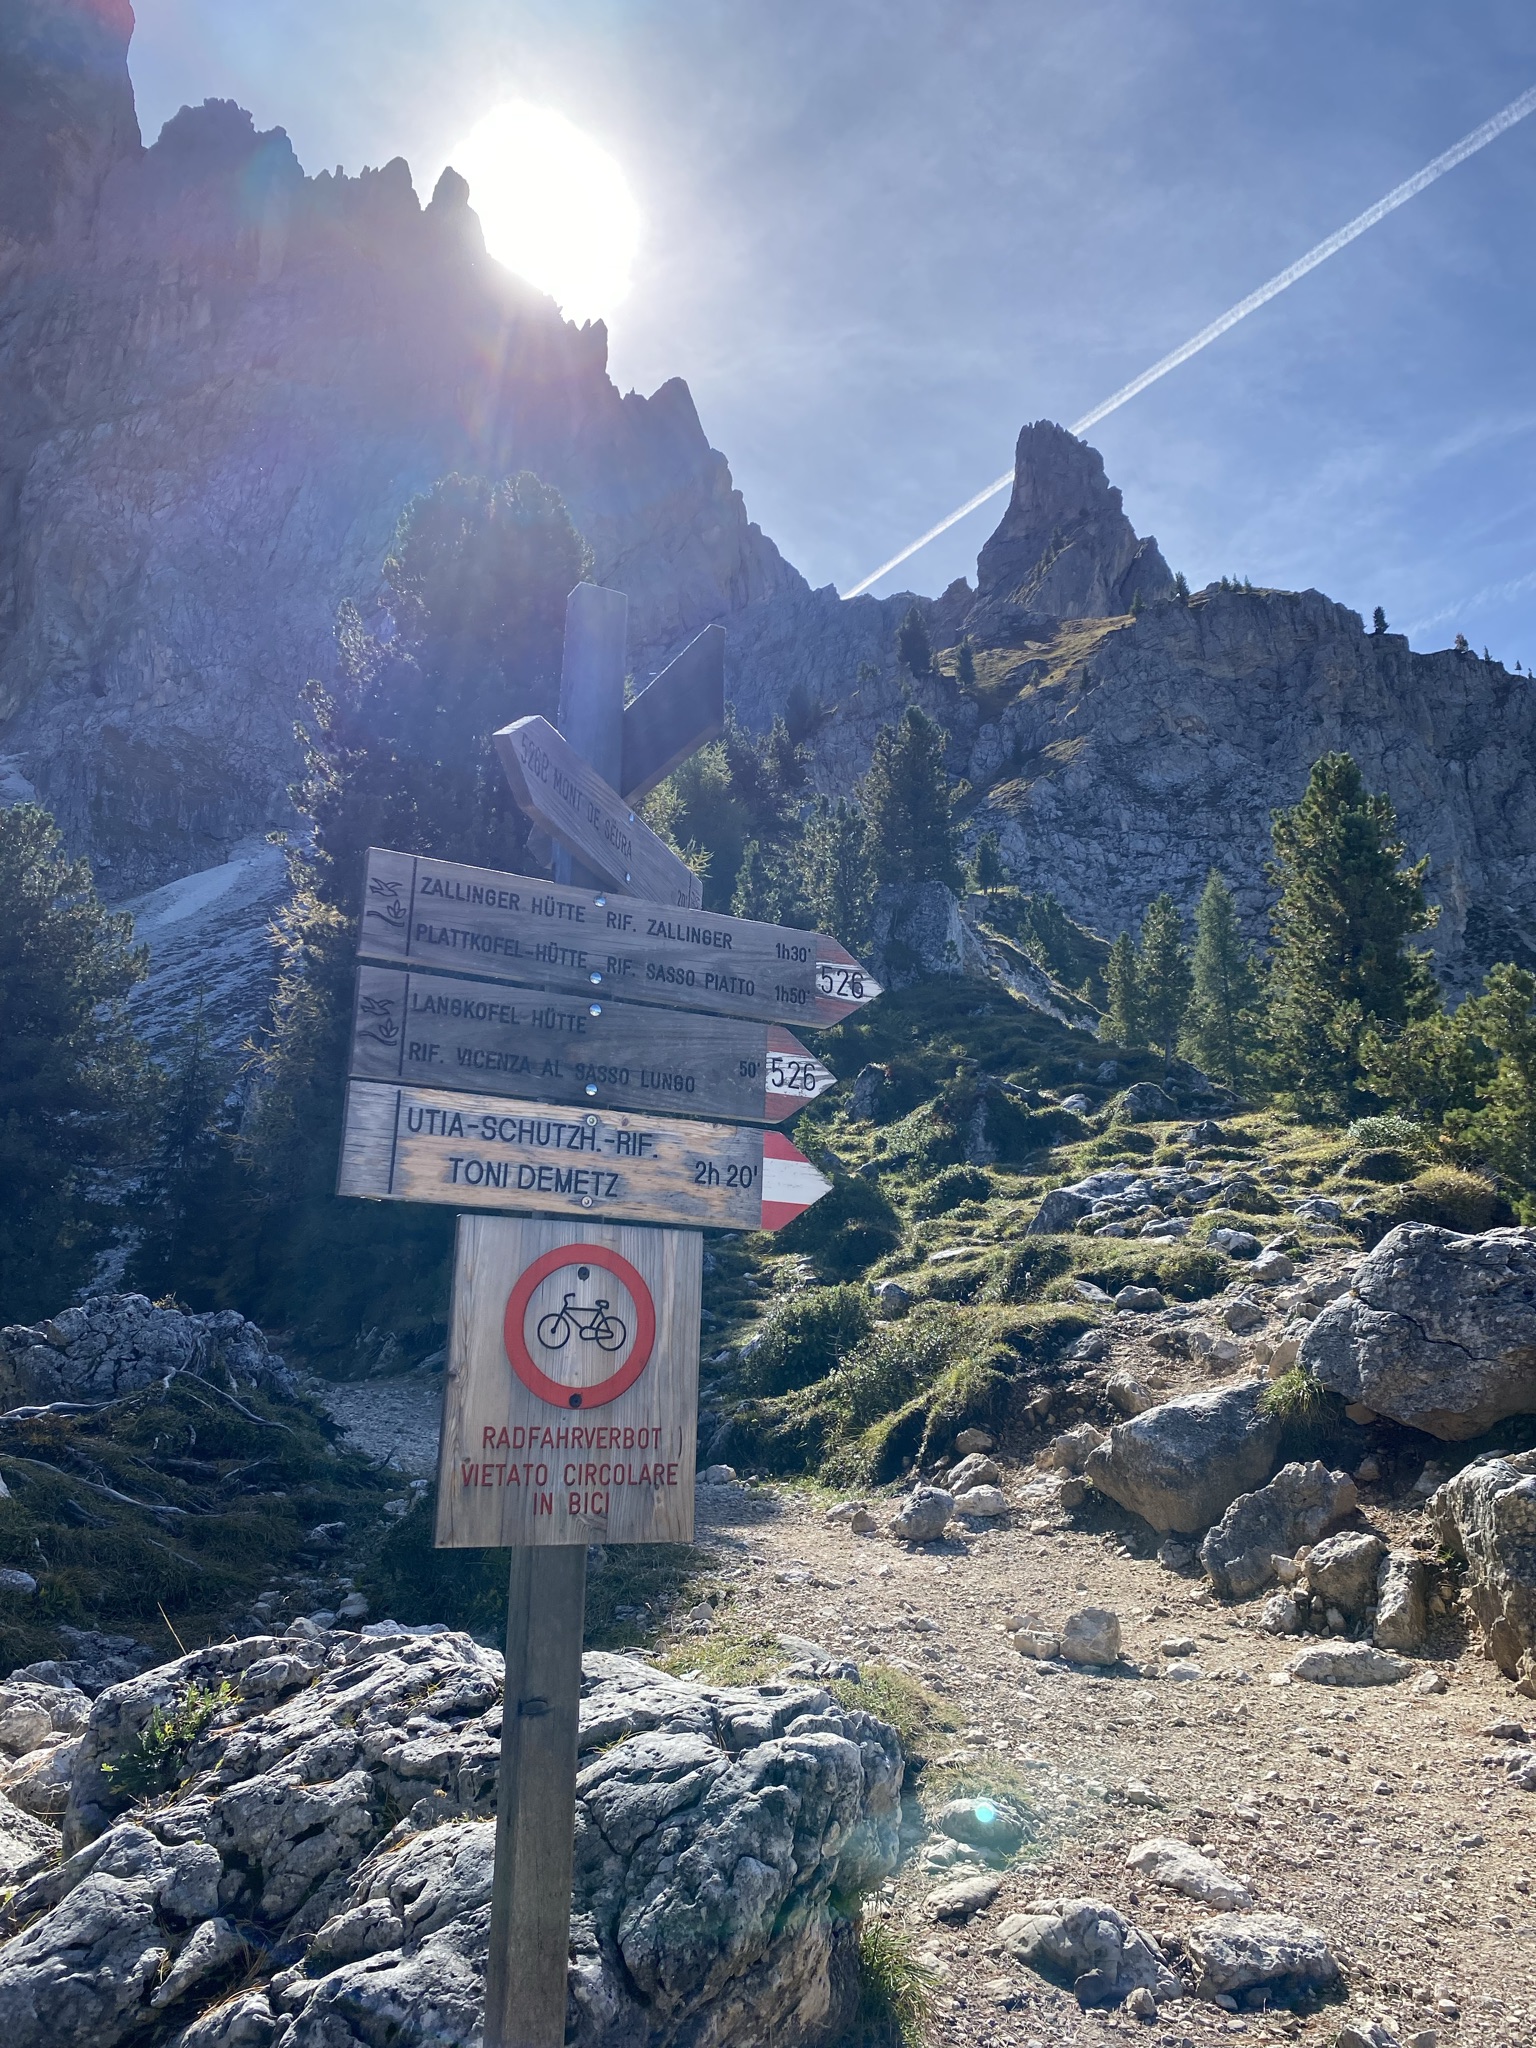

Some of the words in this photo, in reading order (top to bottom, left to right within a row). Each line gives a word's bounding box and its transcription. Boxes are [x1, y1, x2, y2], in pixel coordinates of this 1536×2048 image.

[553, 768, 582, 811] MONT
[588, 802, 600, 831] DE
[420, 877, 520, 911] ZALLINGER
[531, 896, 586, 923] HÜTTE
[606, 911, 637, 932] RIF.
[647, 918, 733, 950] ZALLINGER
[415, 923, 588, 969] PLATTKOFEL-HÜTTE
[606, 956, 636, 977] RIF.
[645, 964, 695, 986] SASSO
[705, 975, 755, 997] PIATTO
[820, 965, 864, 999] 526
[408, 1041, 444, 1064] RIF.
[456, 1047, 531, 1074] VICENZA
[541, 1059, 563, 1078] AL
[575, 1064, 630, 1085] SASSO
[640, 1071, 696, 1093] LUNGO
[740, 1060, 760, 1078] 50'
[771, 1057, 816, 1091] 526
[407, 1106, 658, 1158] UTIA-SCHUTZH.-RIF.
[449, 1157, 508, 1188] TONI
[517, 1164, 620, 1198] DEMETZ
[694, 1160, 720, 1186] 2h
[726, 1164, 758, 1189] 20'
[482, 1426, 662, 1450] RADFAHRVERBOT
[461, 1463, 548, 1487] VIETATO
[563, 1463, 679, 1487] CIRCOLARE
[533, 1492, 553, 1516] IN
[568, 1491, 610, 1516] BICI
